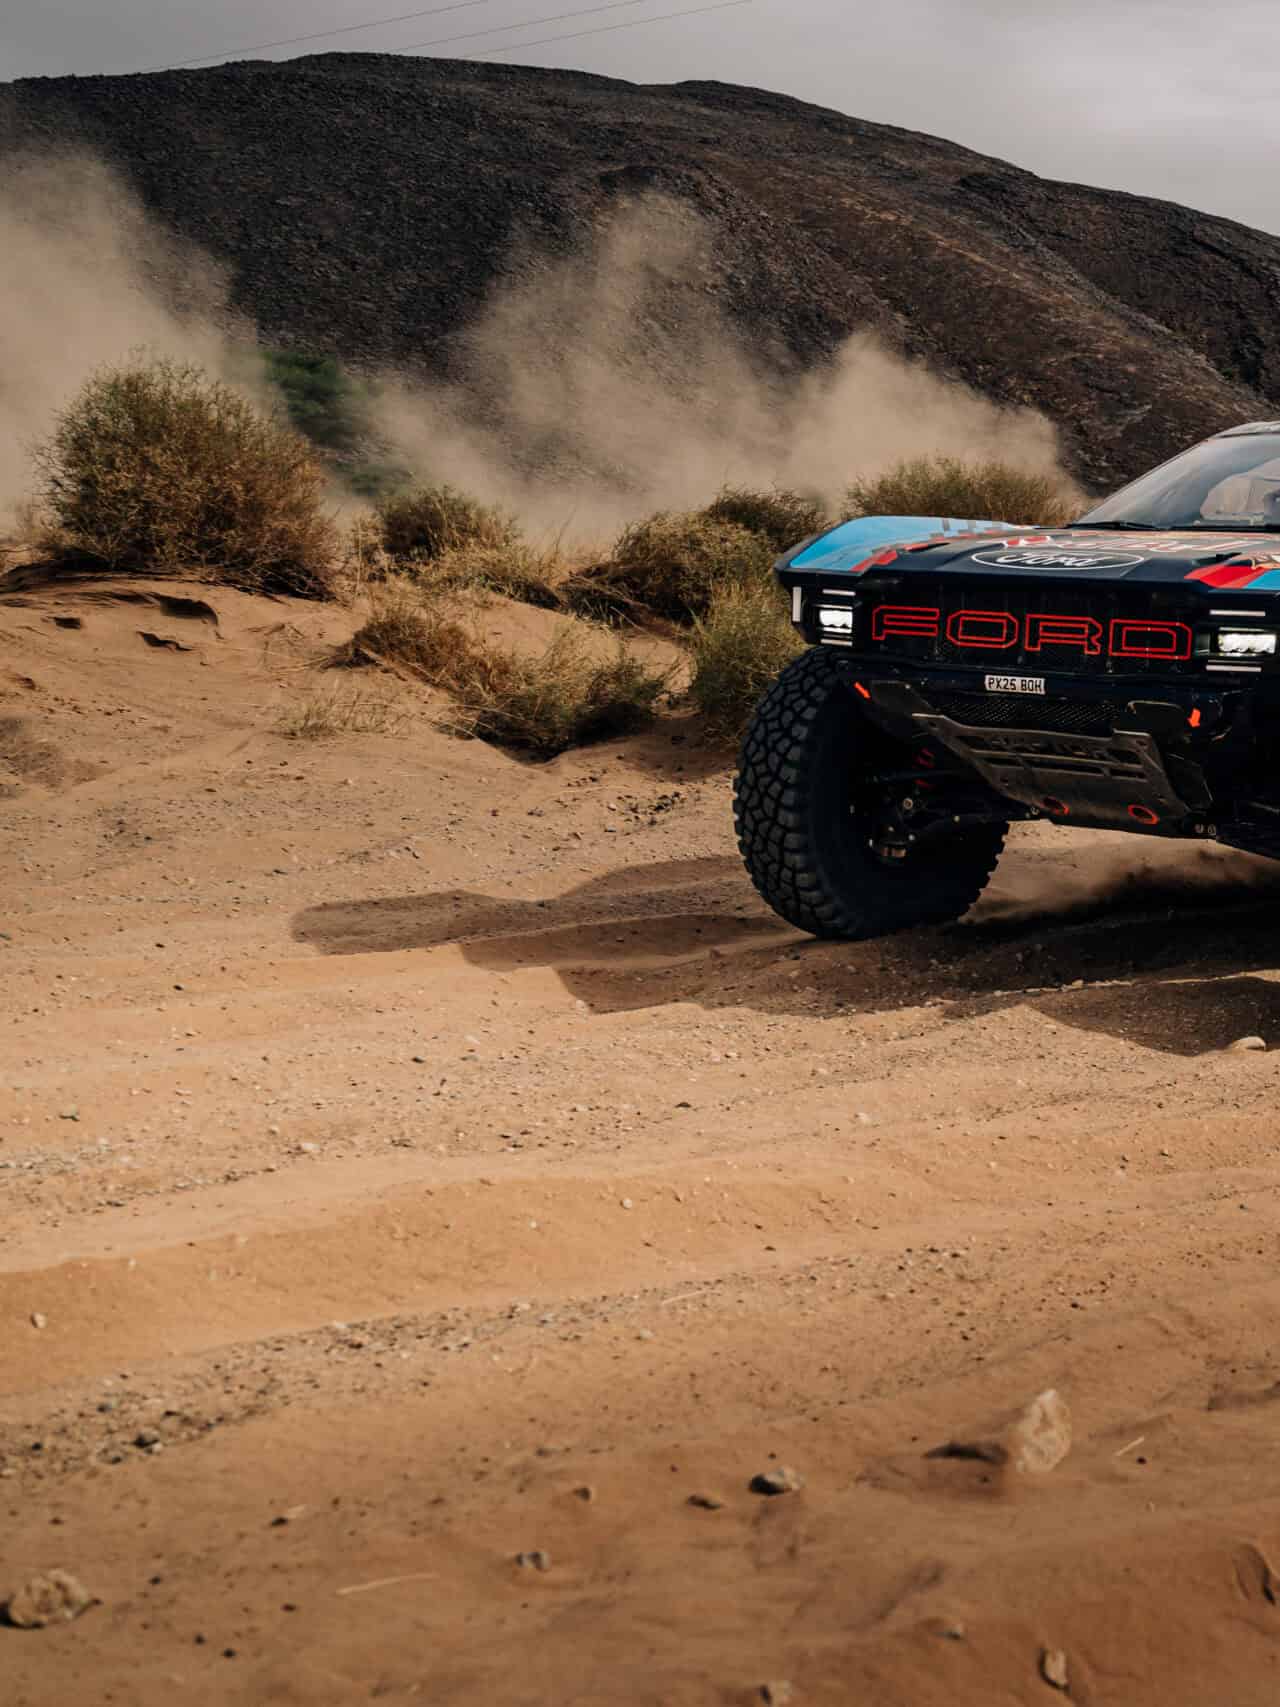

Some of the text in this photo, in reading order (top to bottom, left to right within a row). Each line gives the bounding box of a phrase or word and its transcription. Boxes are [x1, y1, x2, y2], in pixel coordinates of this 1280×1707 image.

[996, 551, 1114, 568] Ford
[871, 605, 1193, 660] FORD
[987, 676, 1018, 691] PX25
